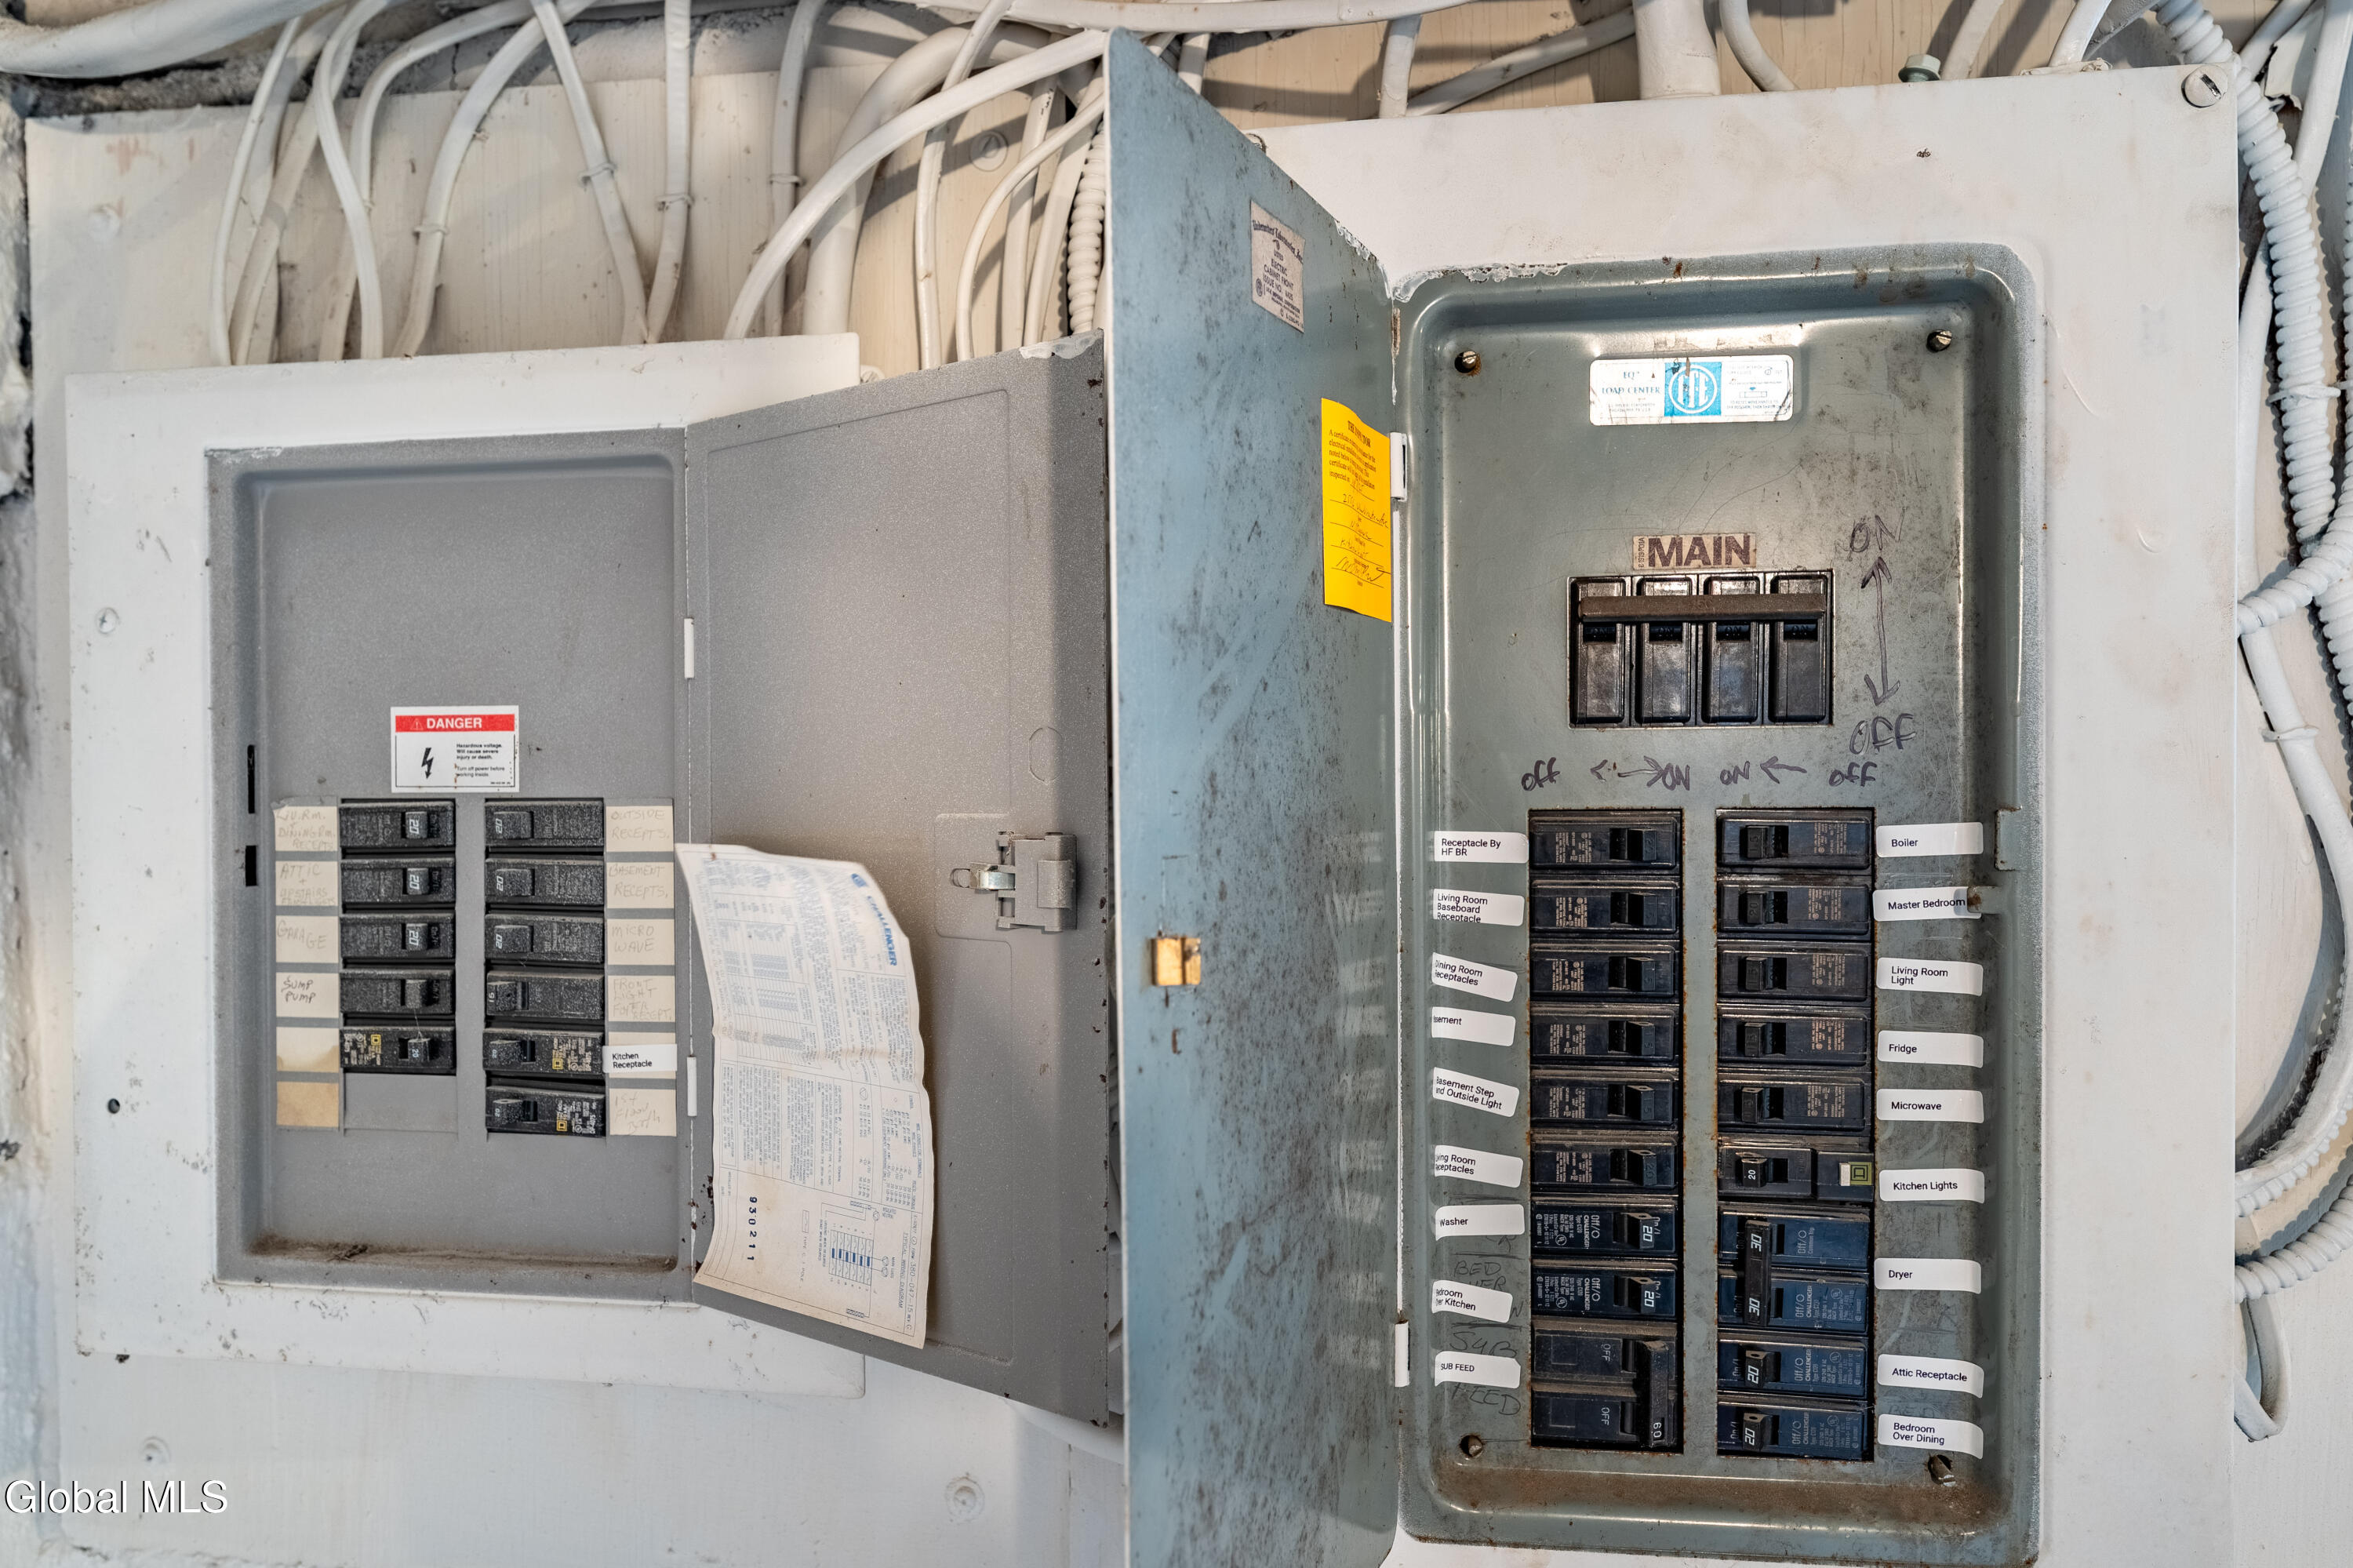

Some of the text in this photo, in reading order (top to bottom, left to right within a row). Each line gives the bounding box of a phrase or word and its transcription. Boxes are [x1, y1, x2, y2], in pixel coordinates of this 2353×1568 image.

[1602, 386, 1661, 395] LOAD CENTER
[1648, 535, 1751, 567] MAIN
[426, 717, 482, 729] DANGER
[409, 819, 420, 835] 20
[495, 818, 503, 835] 20
[1442, 838, 1501, 849] Receptacle By
[1891, 838, 1918, 847] Boiler
[1442, 847, 1467, 857] HF BR
[409, 874, 420, 890] 20
[496, 875, 504, 892] 20
[1437, 893, 1488, 905] Living Room
[1888, 897, 1966, 911] Master Bedroom
[1437, 902, 1481, 914] Baseboard
[1437, 911, 1482, 923] Receptacle
[409, 929, 420, 946] 20
[495, 933, 503, 949] 20
[1458, 965, 1483, 977] Room
[1891, 966, 1949, 977] Living Room
[1891, 976, 1915, 986] Light
[411, 1048, 420, 1059] 20
[1889, 1043, 1918, 1054] Fridge
[612, 1052, 639, 1060] Kitchen
[613, 1060, 653, 1069] Receptacle
[1446, 1088, 1479, 1104] Outside
[1481, 1097, 1502, 1109] Light
[1475, 1086, 1495, 1098] Step
[1891, 1101, 1942, 1111] Microwave
[1450, 1154, 1476, 1166] Room
[1747, 1169, 1756, 1181] 20
[1893, 1181, 1958, 1191] Kitchen Lights
[1439, 1217, 1469, 1228] Washer
[1642, 1224, 1653, 1242] 20
[1750, 1233, 1762, 1252] 30
[1454, 1260, 1501, 1277] BED
[1889, 1269, 1913, 1280] Dryer
[898, 1281, 907, 1309] DIAGRAM
[1644, 1290, 1654, 1308] 20
[1445, 1297, 1476, 1311] Kitchen
[1748, 1297, 1760, 1317] 30
[1601, 1343, 1611, 1362] OFF
[1747, 1365, 1759, 1384] 20
[1892, 1367, 1968, 1381] Attic Receptacle
[1601, 1406, 1610, 1426] OFF
[1653, 1421, 1663, 1439] 60
[1893, 1422, 1936, 1434] Bedroom
[1744, 1428, 1755, 1446] 20
[1893, 1432, 1945, 1446] Over Dining
